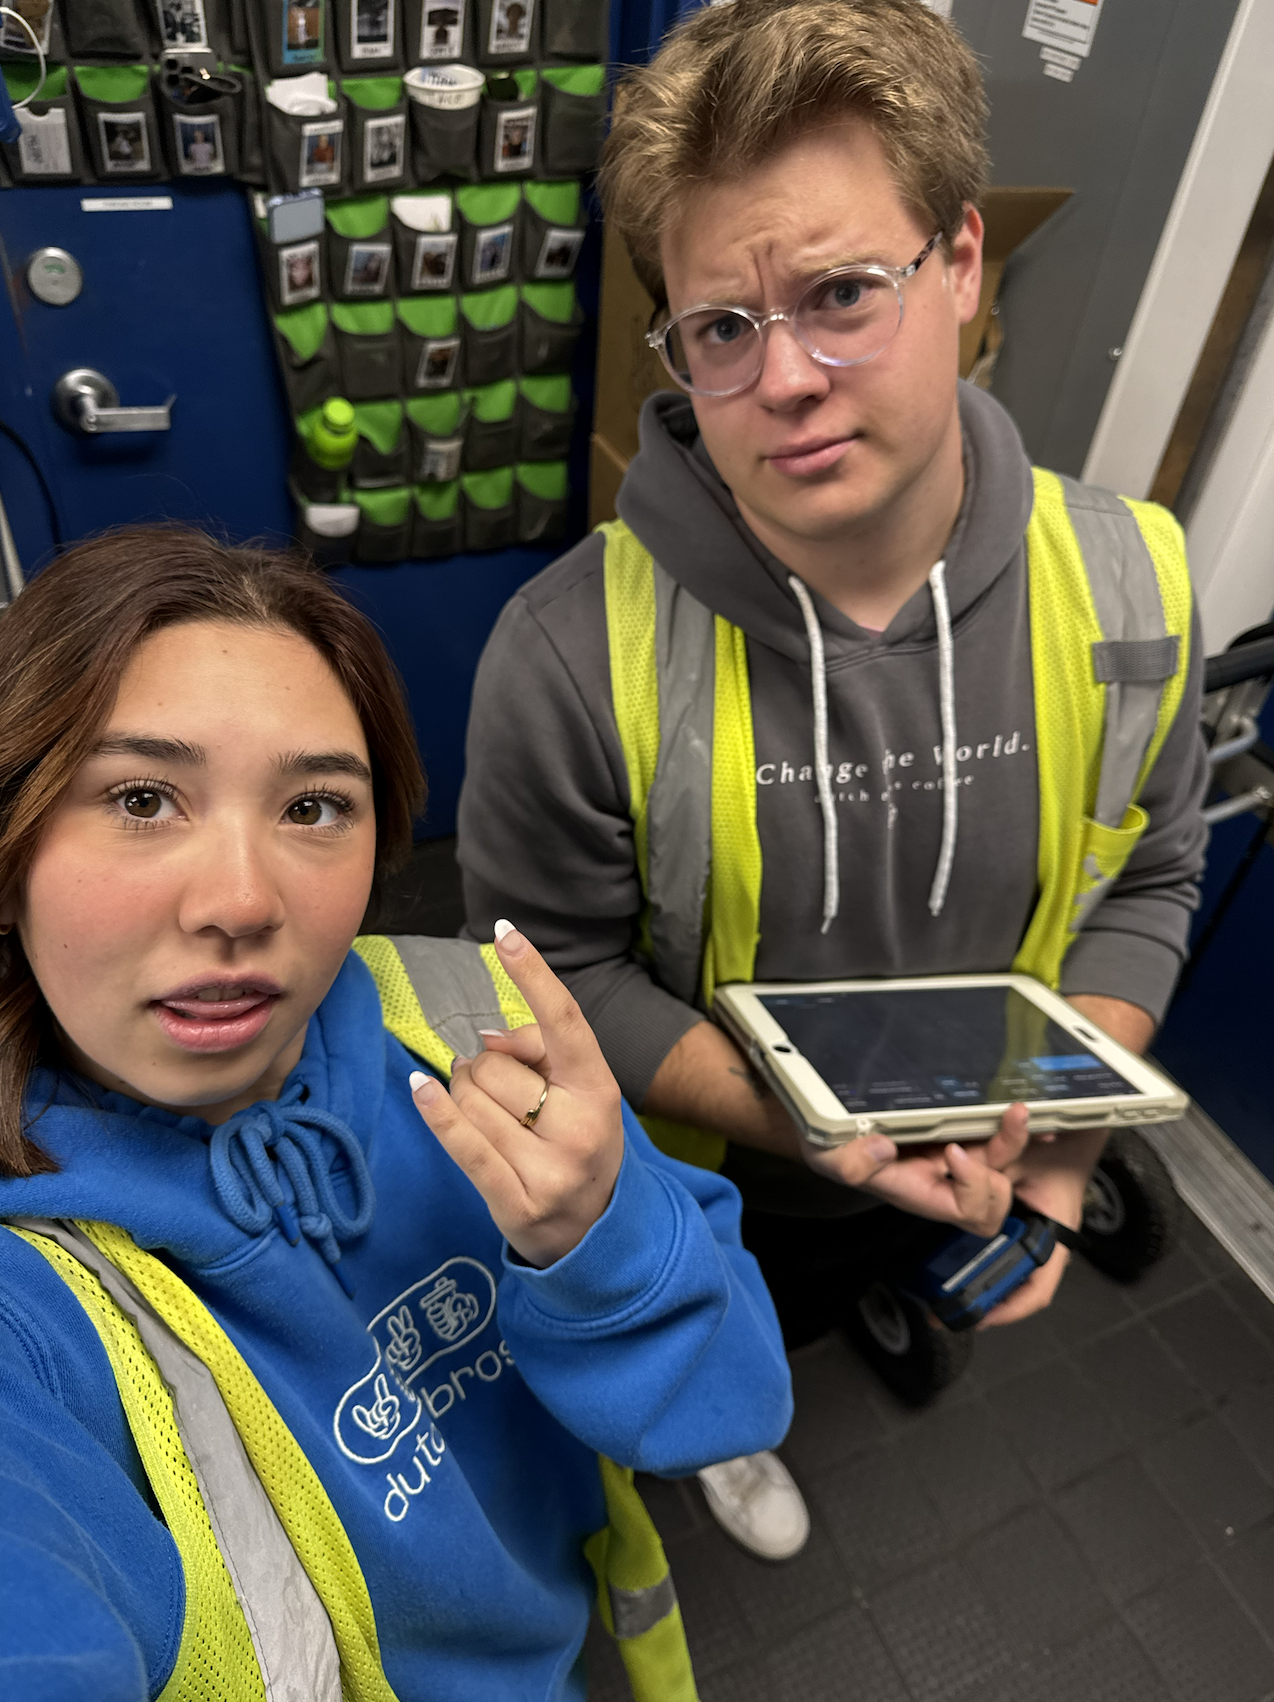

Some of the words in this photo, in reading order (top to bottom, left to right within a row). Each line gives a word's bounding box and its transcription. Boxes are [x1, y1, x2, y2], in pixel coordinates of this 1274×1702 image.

[882, 749, 915, 775] he
[813, 789, 871, 803] tch
[383, 1422, 446, 1522] dutc
